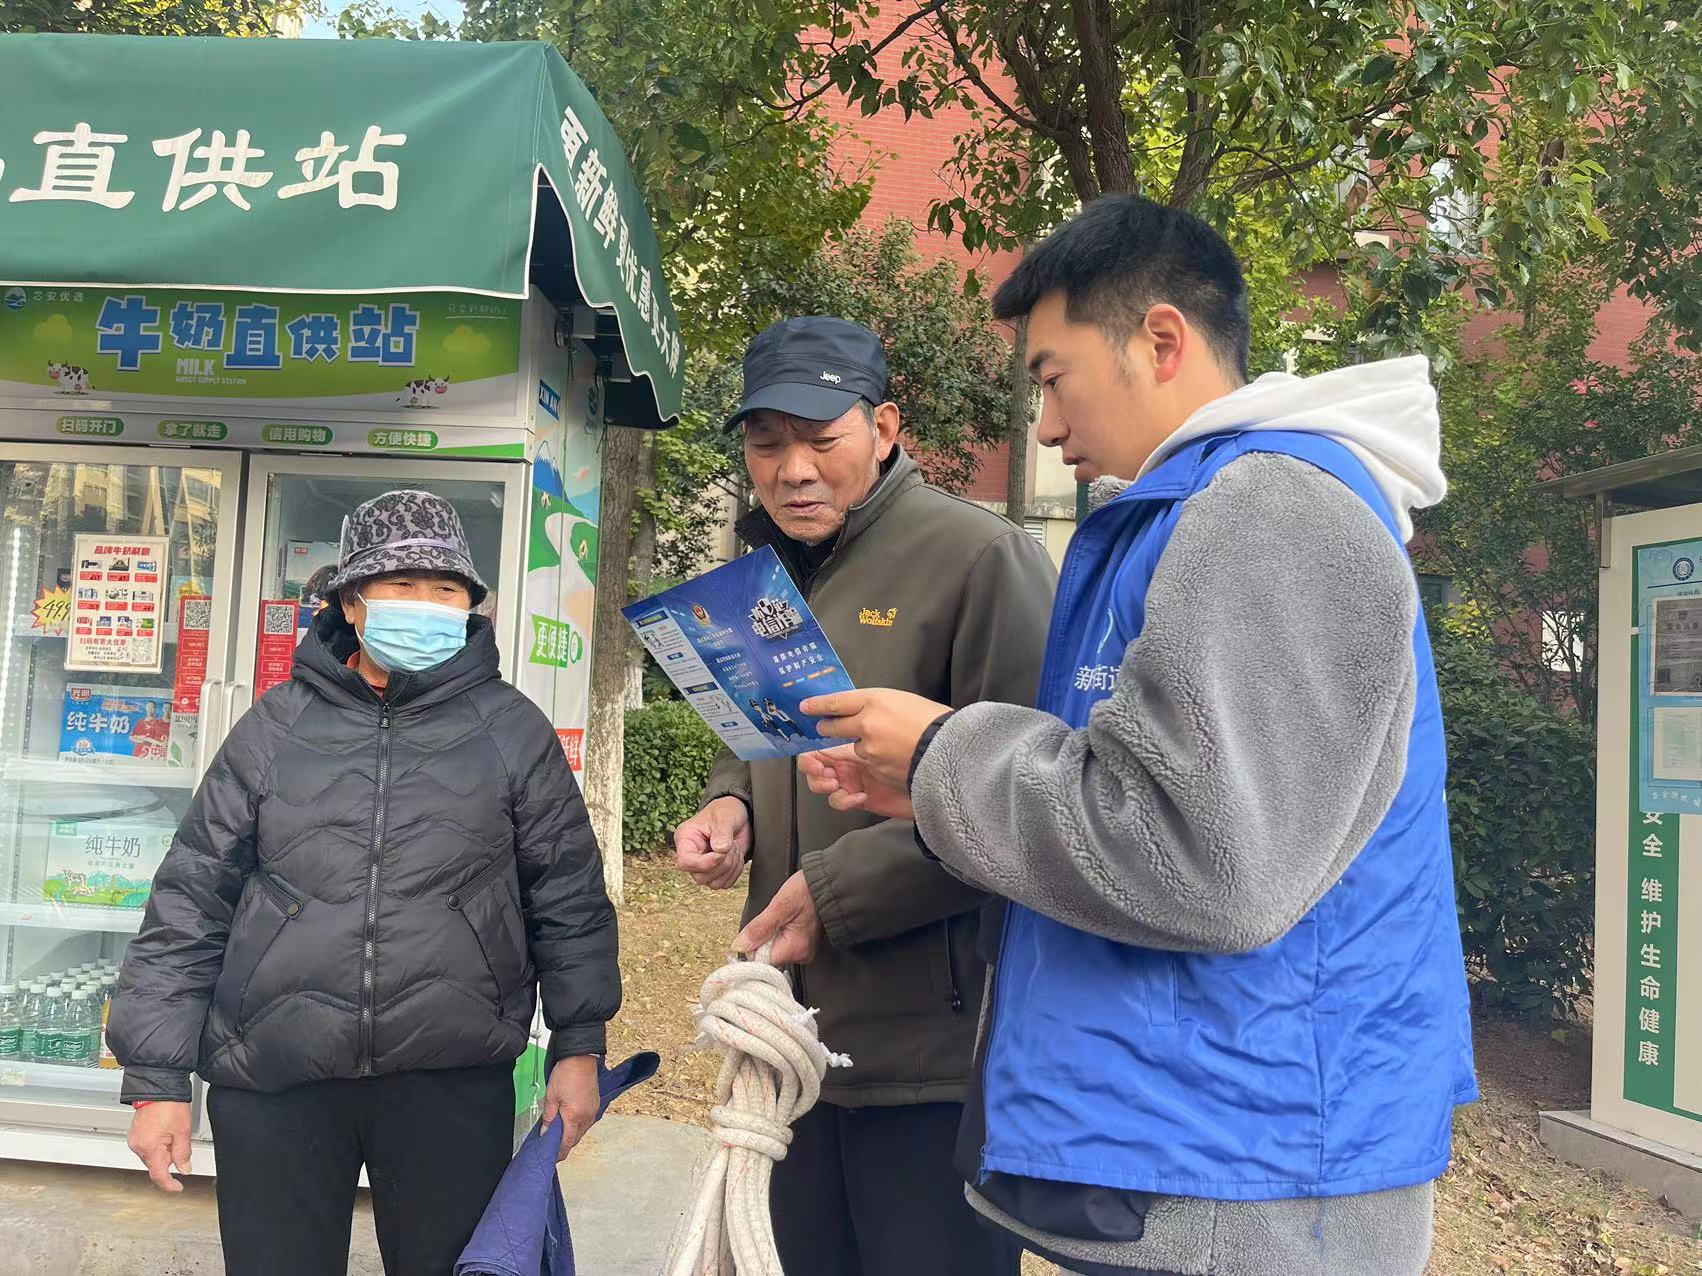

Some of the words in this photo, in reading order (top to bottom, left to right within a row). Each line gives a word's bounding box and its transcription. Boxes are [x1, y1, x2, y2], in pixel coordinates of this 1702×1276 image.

[0, 122, 407, 212] 直供站
[96, 294, 421, 371] 牛奶直供站
[176, 358, 216, 376] MILK
[819, 370, 841, 385] Jeep
[61, 419, 117, 434] 扫码开门
[163, 421, 221, 439] 拿了就走
[268, 427, 327, 443] 信用购物
[374, 431, 433, 448] 方便快捷
[858, 607, 881, 619] Jack
[858, 615, 893, 627] Wolfskin
[66, 711, 130, 735] 纯牛奶
[85, 834, 141, 858] 纯牛奶
